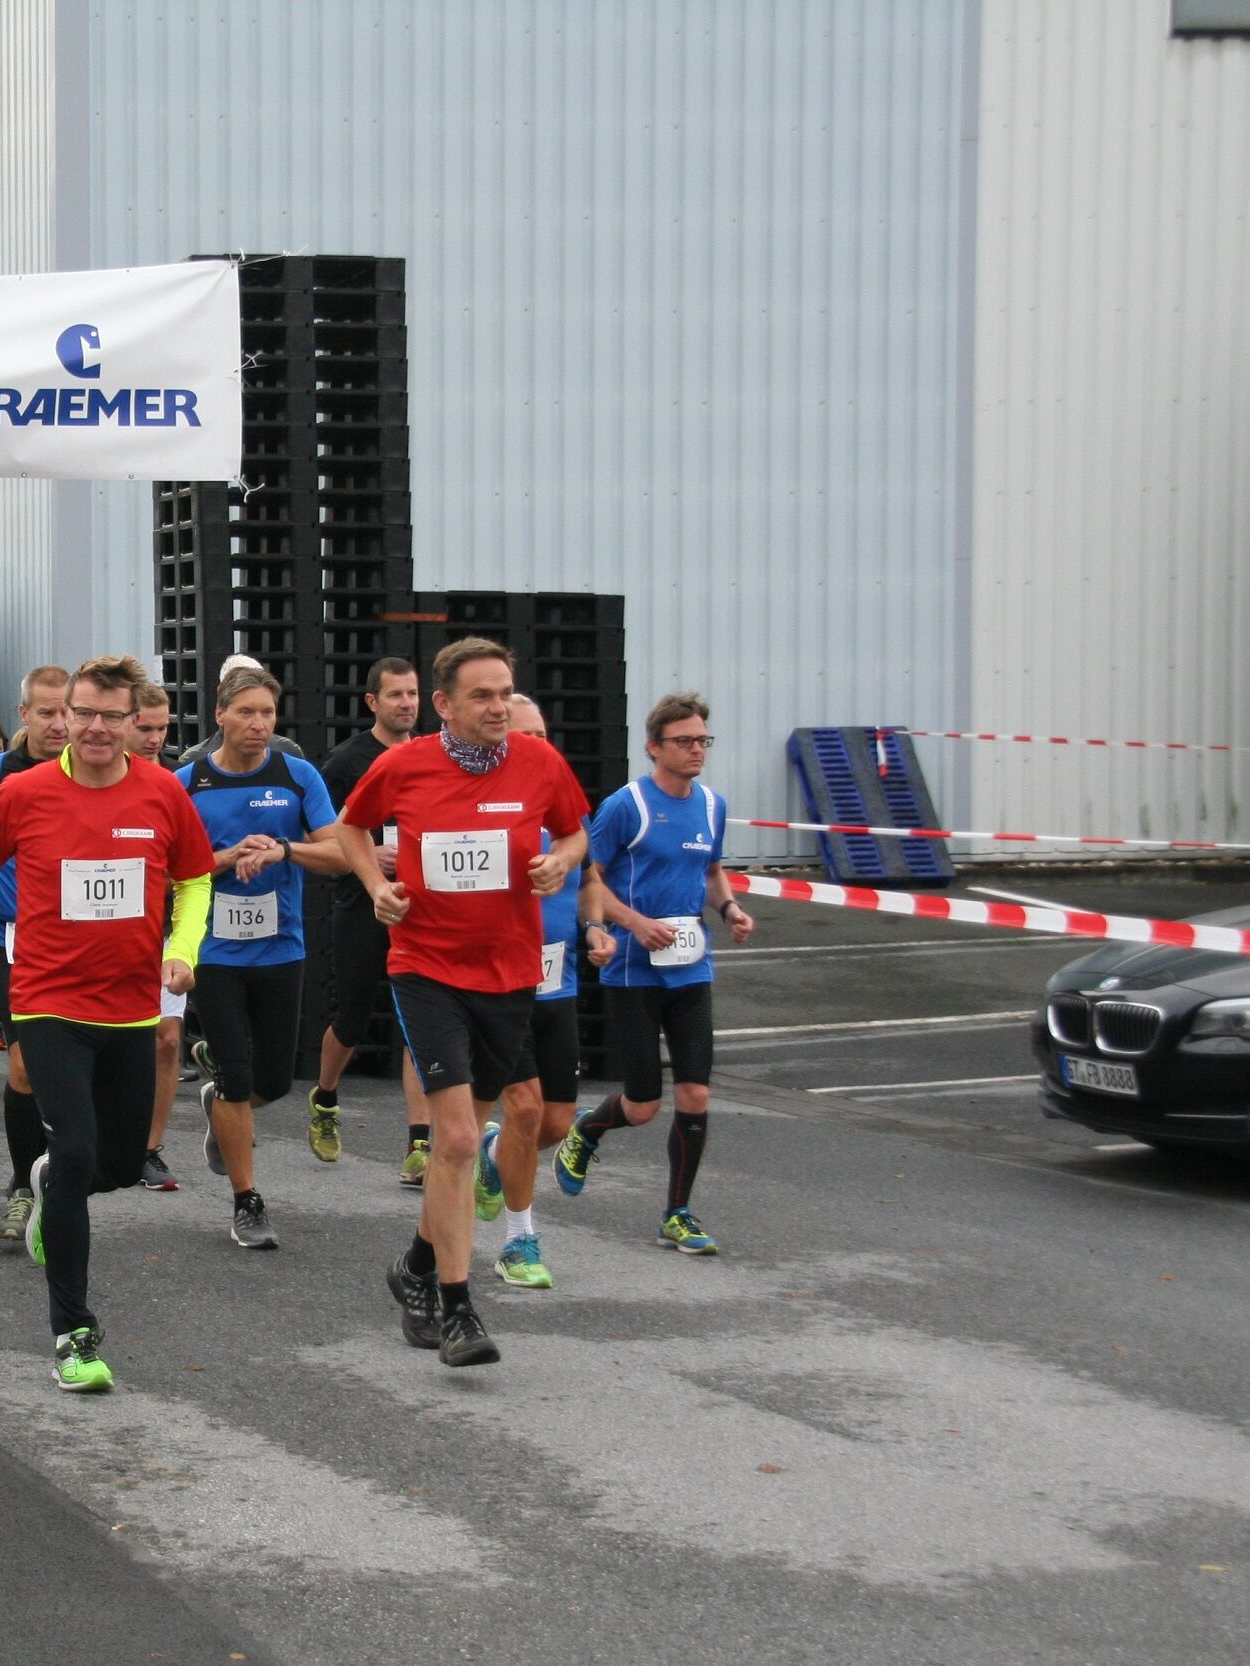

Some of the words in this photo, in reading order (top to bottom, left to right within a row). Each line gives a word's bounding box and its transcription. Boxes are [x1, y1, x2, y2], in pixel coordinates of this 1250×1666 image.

[249, 799, 289, 808] CRAEMER
[441, 849, 490, 873] 1012
[83, 878, 125, 901] 1011
[228, 908, 264, 926] 1136
[666, 931, 696, 949] 150
